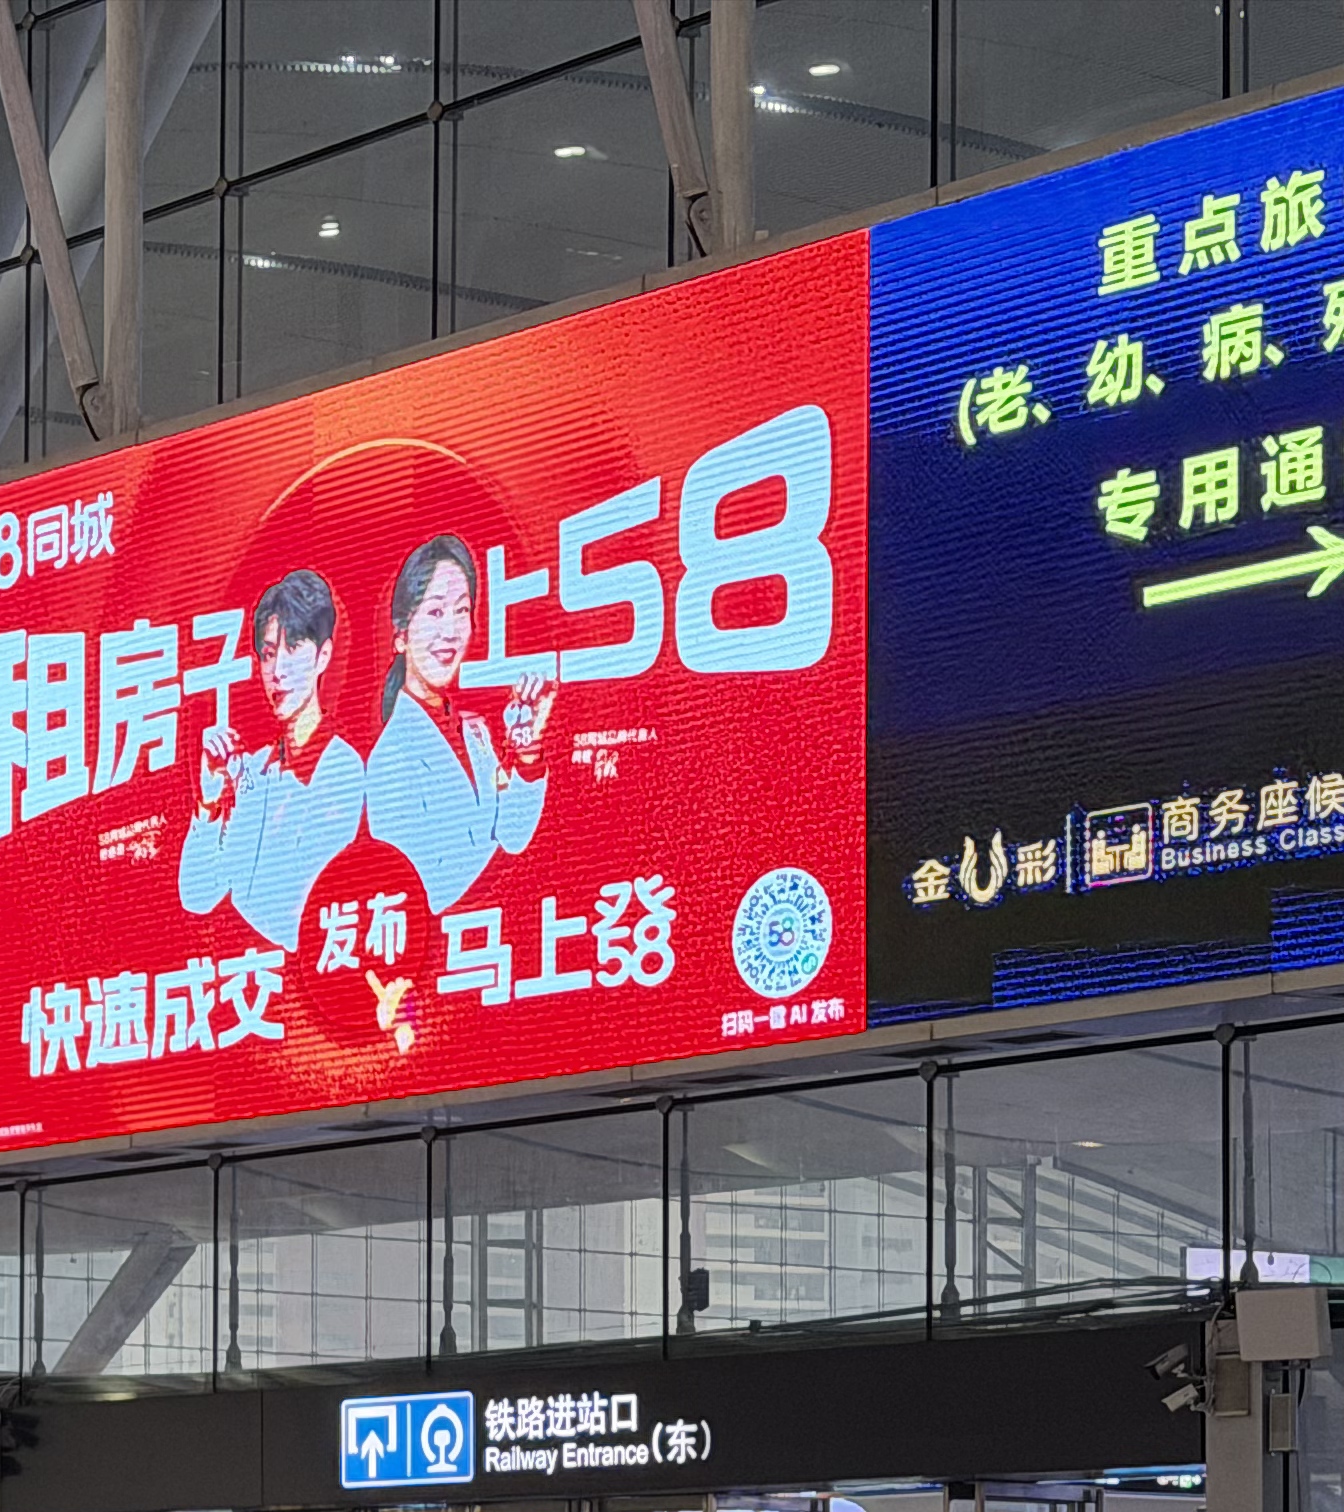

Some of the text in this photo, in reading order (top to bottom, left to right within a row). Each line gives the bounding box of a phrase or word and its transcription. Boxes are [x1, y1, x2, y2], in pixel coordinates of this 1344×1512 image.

[1097, 169, 1327, 298] 重点旅
[1097, 426, 1327, 546] 专用通
[1161, 772, 1344, 843] 商务座候
[1161, 823, 1344, 870] Business Class
[316, 890, 408, 974] 发布
[21, 948, 286, 1078] 快速成交
[811, 997, 845, 1024] 发布
[484, 1390, 638, 1442] 铁路进站口
[652, 1418, 712, 1465] (东)
[484, 1441, 650, 1476] Railway Entrance
